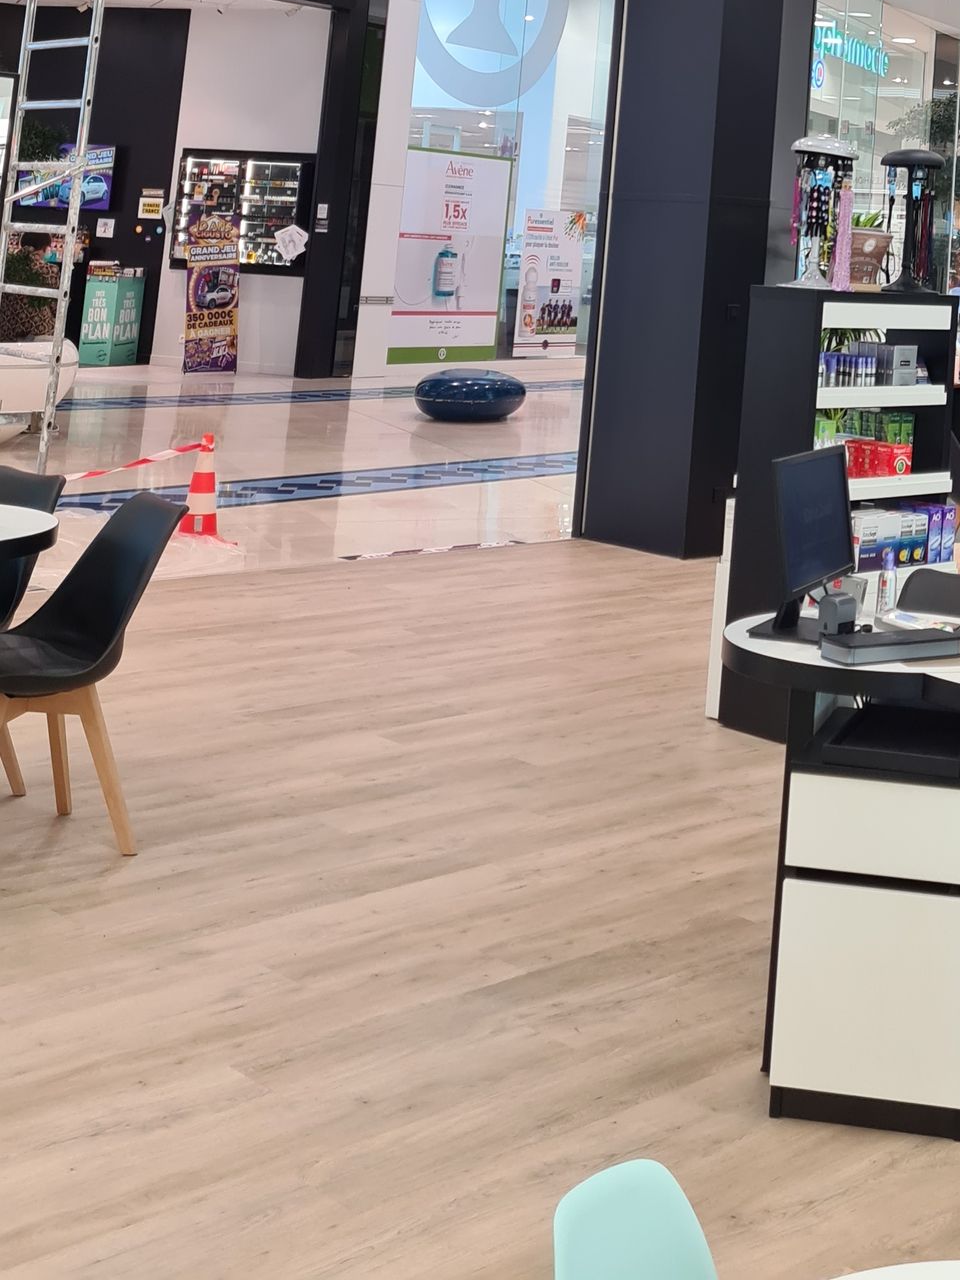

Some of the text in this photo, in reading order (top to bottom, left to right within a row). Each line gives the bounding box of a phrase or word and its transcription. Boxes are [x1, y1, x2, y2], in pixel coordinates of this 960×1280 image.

[445, 160, 474, 177] Avène
[190, 244, 237, 255] GRAND JEU
[88, 308, 107, 322] BON
[120, 308, 137, 324] BON
[82, 322, 110, 340] PLAN
[198, 319, 234, 328] CADEAUX
[114, 323, 138, 341] PLAN
